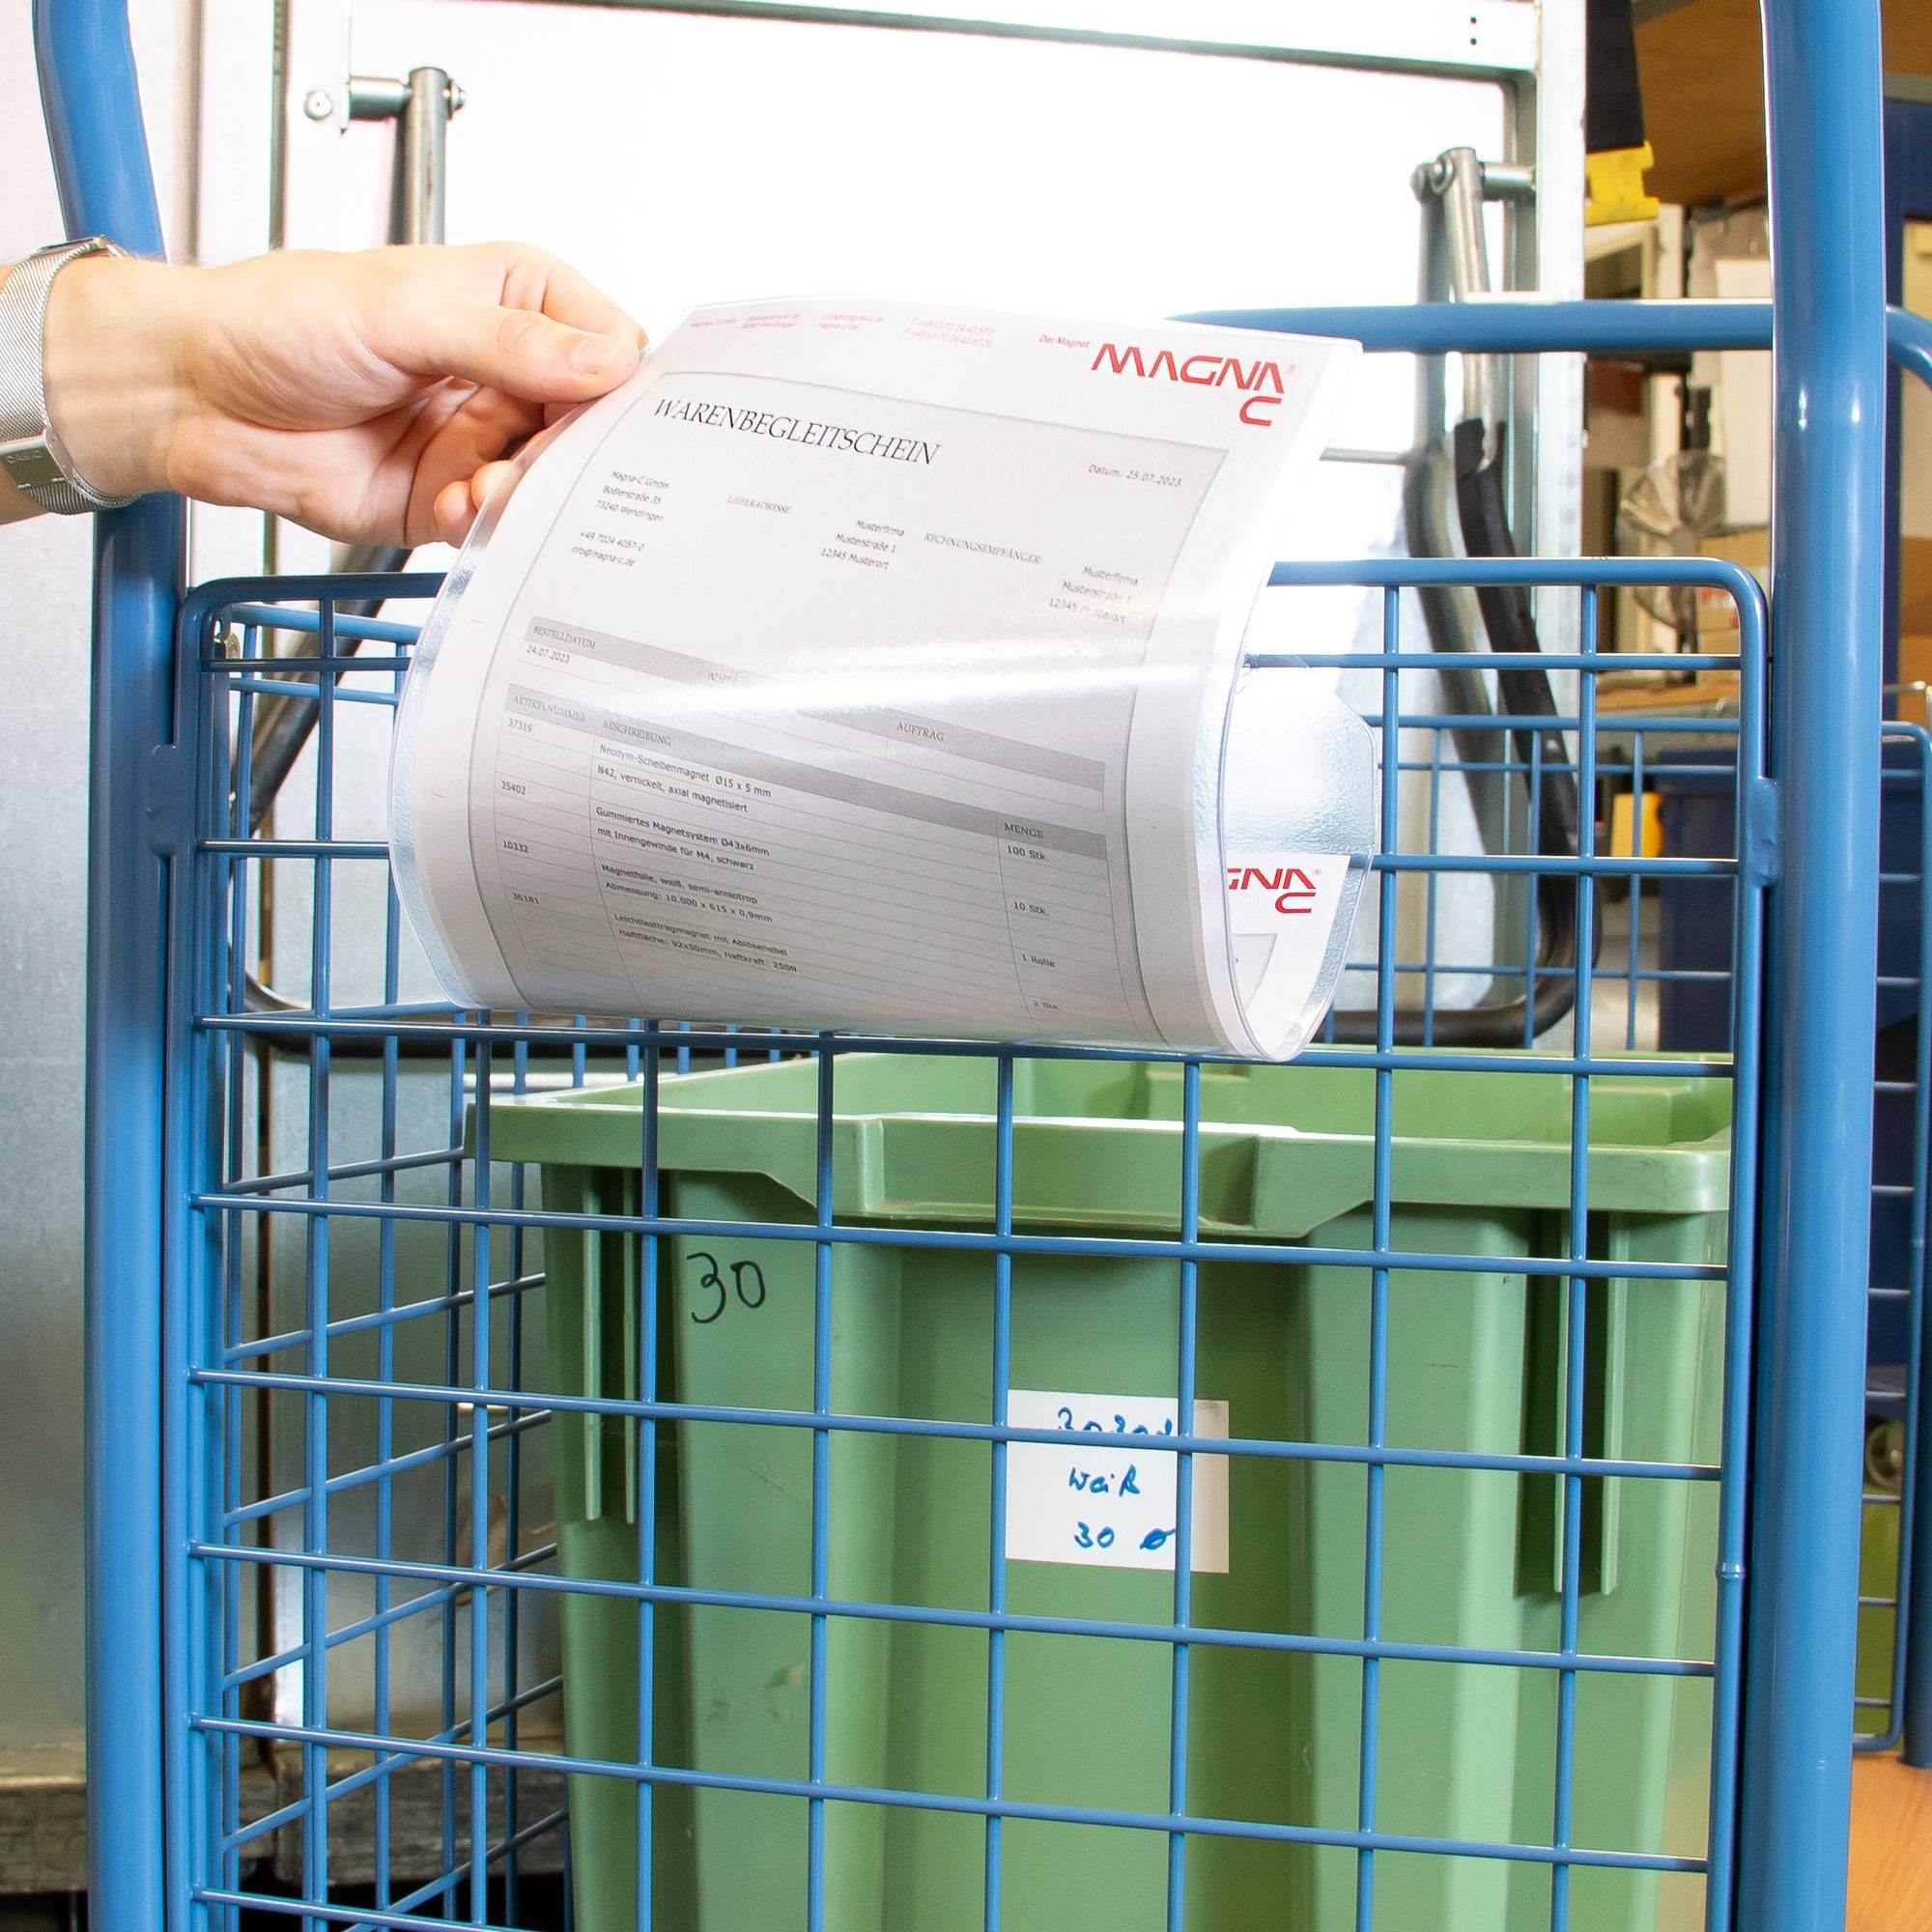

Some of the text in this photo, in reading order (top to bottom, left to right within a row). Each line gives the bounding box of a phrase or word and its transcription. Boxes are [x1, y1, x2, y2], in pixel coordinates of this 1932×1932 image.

[1091, 343, 1285, 394] MAGNA
[1238, 395, 1283, 427] C
[654, 398, 943, 466] WARENBEGLEITSCHEIN
[896, 721, 945, 742] AUFTRAG
[600, 744, 710, 783] Neodym-Scheibenmagnet
[753, 786, 771, 798] mm
[668, 784, 690, 798] axial
[692, 792, 748, 813] magnetisiert
[596, 807, 650, 829] Gummiertes
[652, 821, 719, 844] Magnetsystem
[1005, 823, 1044, 838] MENGE
[597, 827, 612, 838] mit
[613, 830, 678, 854] Innengewinde
[716, 856, 754, 871] schwarz
[1008, 844, 1026, 857] 100
[1013, 901, 1026, 911] 10
[1275, 893, 1316, 913] C
[686, 1252, 766, 1324] 30
[1074, 1521, 1115, 1548] 30
